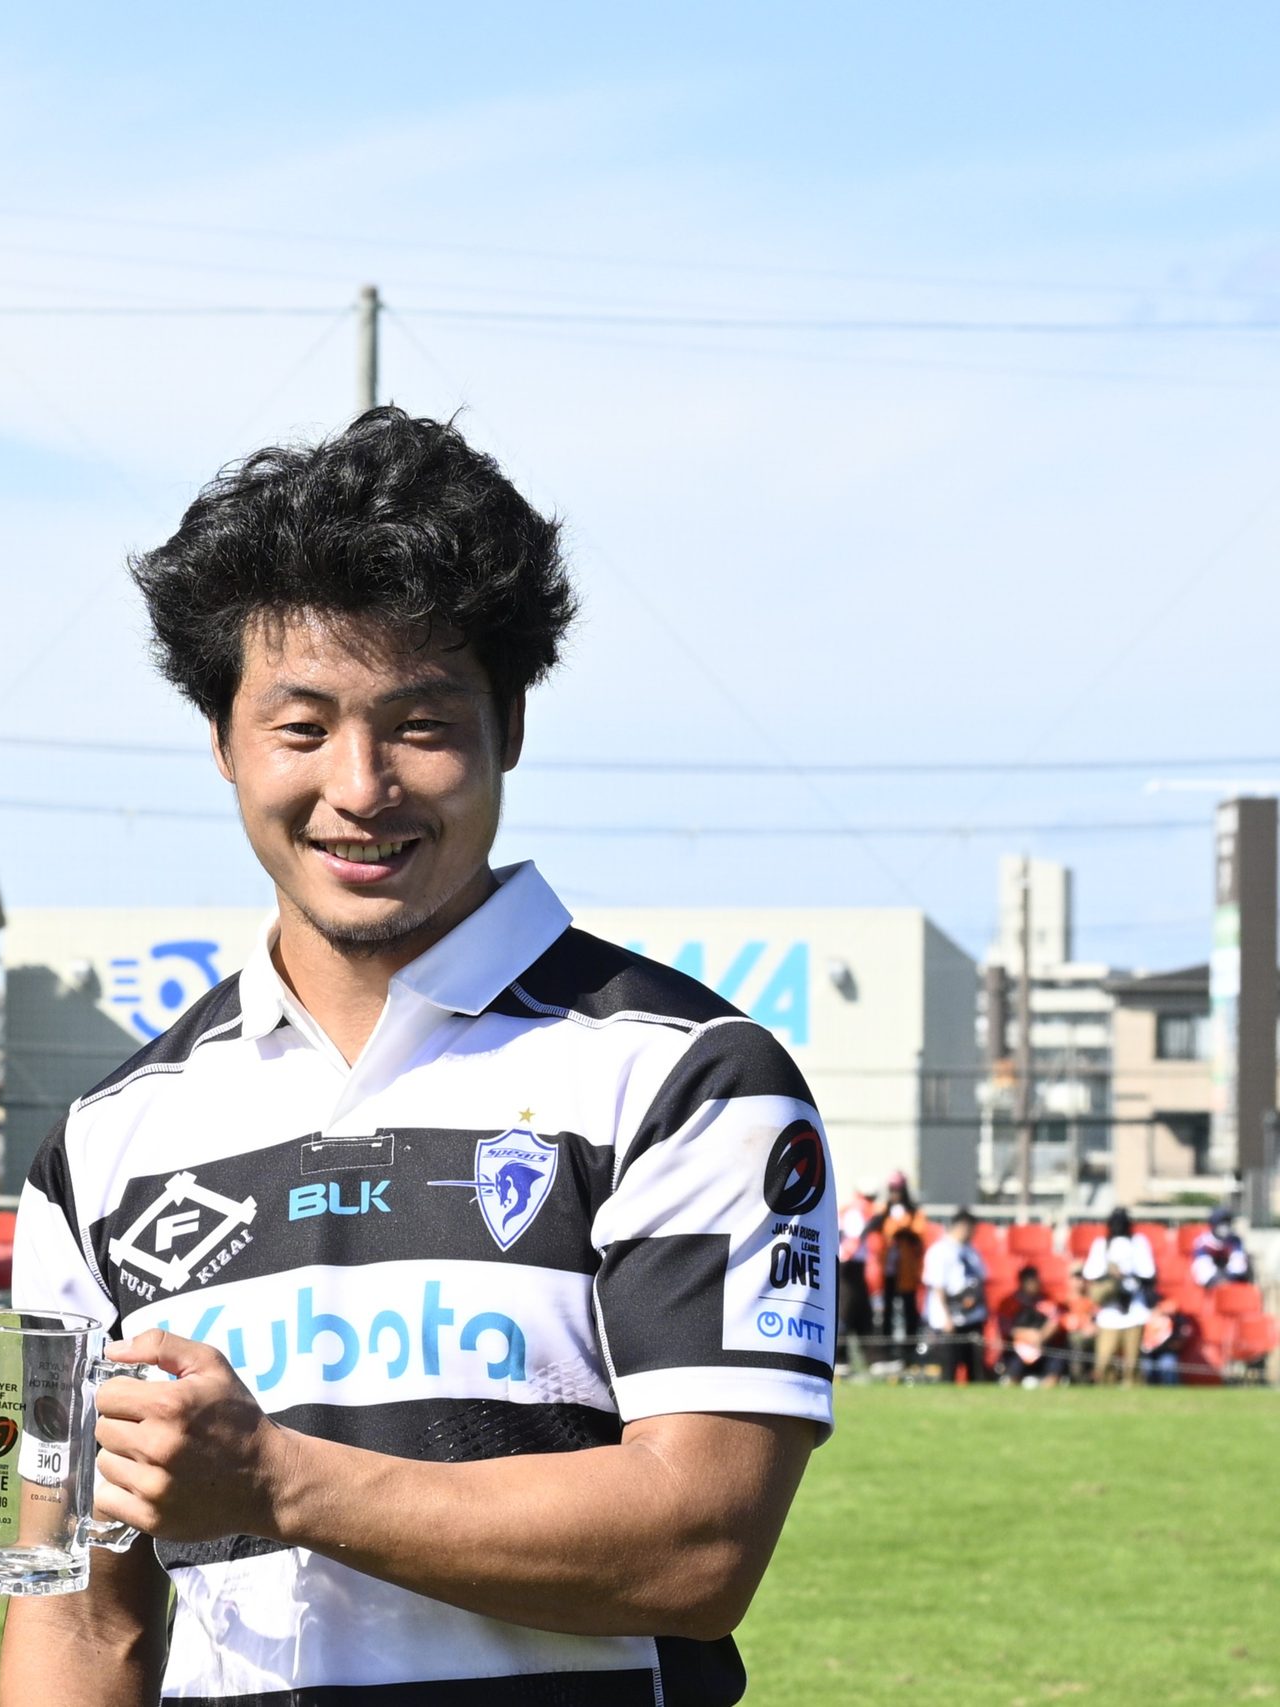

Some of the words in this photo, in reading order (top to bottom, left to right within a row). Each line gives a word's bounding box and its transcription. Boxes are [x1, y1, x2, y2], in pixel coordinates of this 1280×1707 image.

[288, 1180, 392, 1222] BLK
[772, 1222, 799, 1238] JAPAN
[799, 1226, 820, 1243] RUGBY
[118, 1268, 158, 1302] FUJI
[195, 1228, 255, 1285] KIZAI
[769, 1241, 821, 1291] ONE
[787, 1317, 825, 1344] NTT
